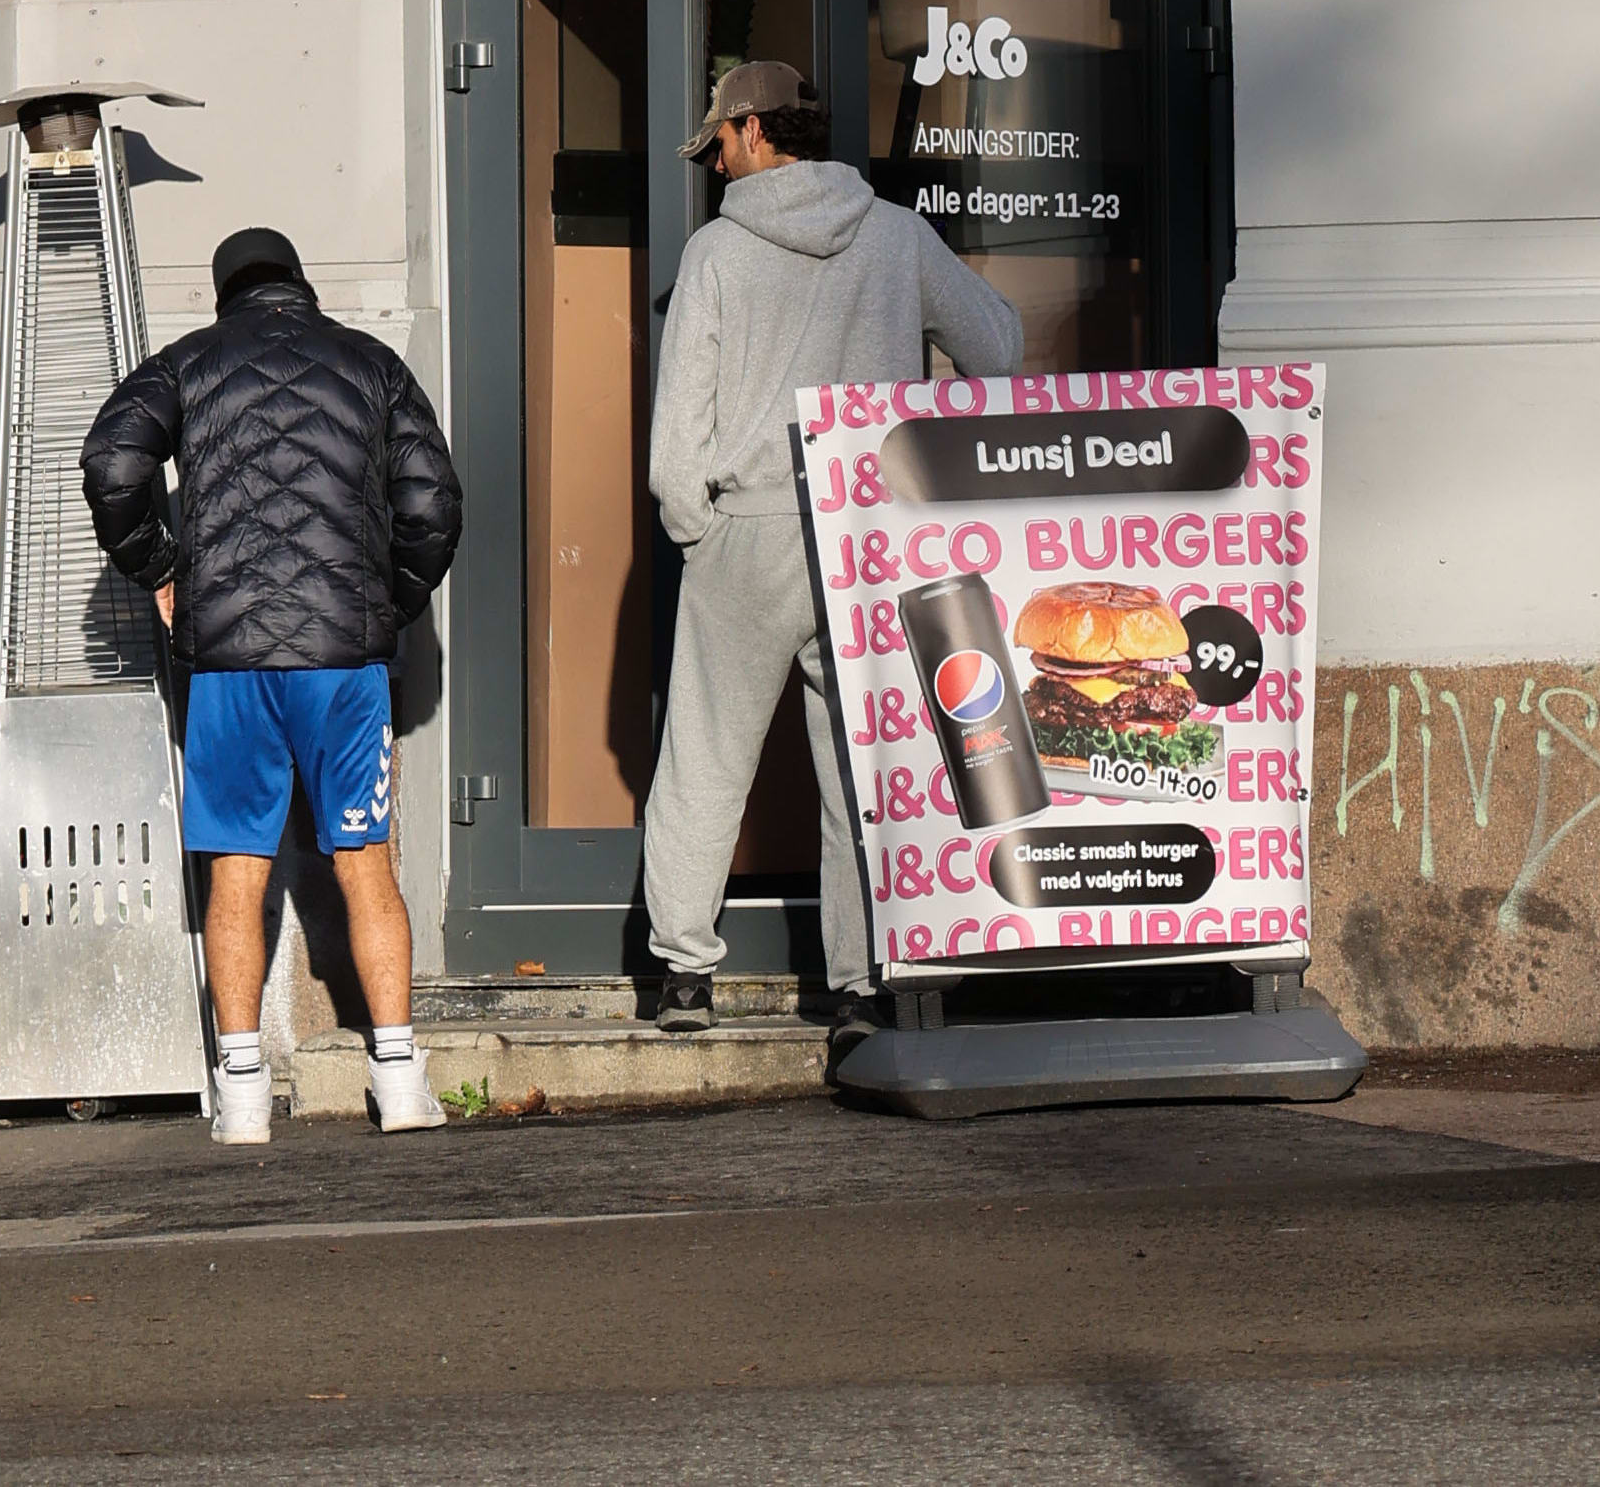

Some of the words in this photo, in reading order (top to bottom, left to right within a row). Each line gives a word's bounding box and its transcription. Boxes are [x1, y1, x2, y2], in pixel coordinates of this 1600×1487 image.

[913, 6, 1028, 86] J&Co
[914, 122, 1081, 159] ÅPNINGSTIDER:
[915, 184, 961, 214] Alle
[967, 185, 1049, 223] dager:
[1054, 192, 1120, 219] 11-23
[976, 434, 1075, 478] Lunsj
[1085, 430, 1173, 468] Deal
[828, 520, 1003, 590] J&CO
[1025, 511, 1309, 571] BURGERS
[1196, 641, 1260, 679] 99,-
[1013, 842, 1076, 863] Classic
[1079, 841, 1136, 860] smash
[1141, 840, 1199, 863] burger
[1041, 871, 1081, 890] med
[1085, 869, 1142, 893] valgfri
[1146, 869, 1183, 888] brus
